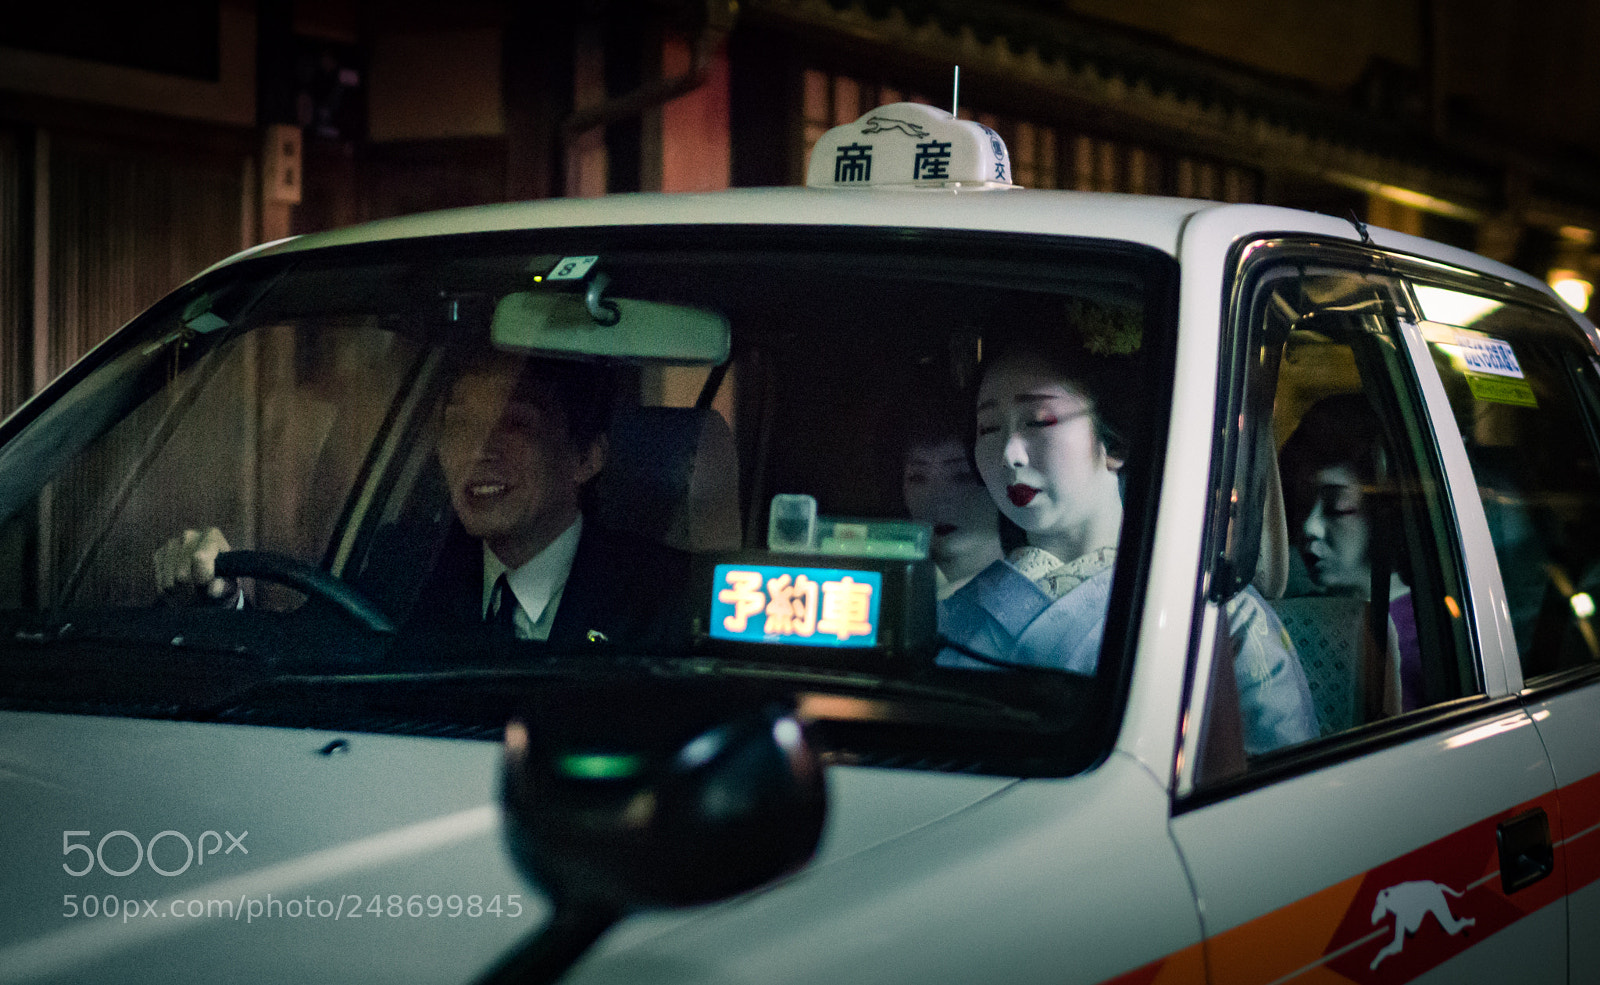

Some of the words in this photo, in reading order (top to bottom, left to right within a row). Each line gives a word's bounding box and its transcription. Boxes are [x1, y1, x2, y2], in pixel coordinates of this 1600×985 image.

[834, 140, 952, 182] 帝産
[718, 570, 873, 641] 予約車
